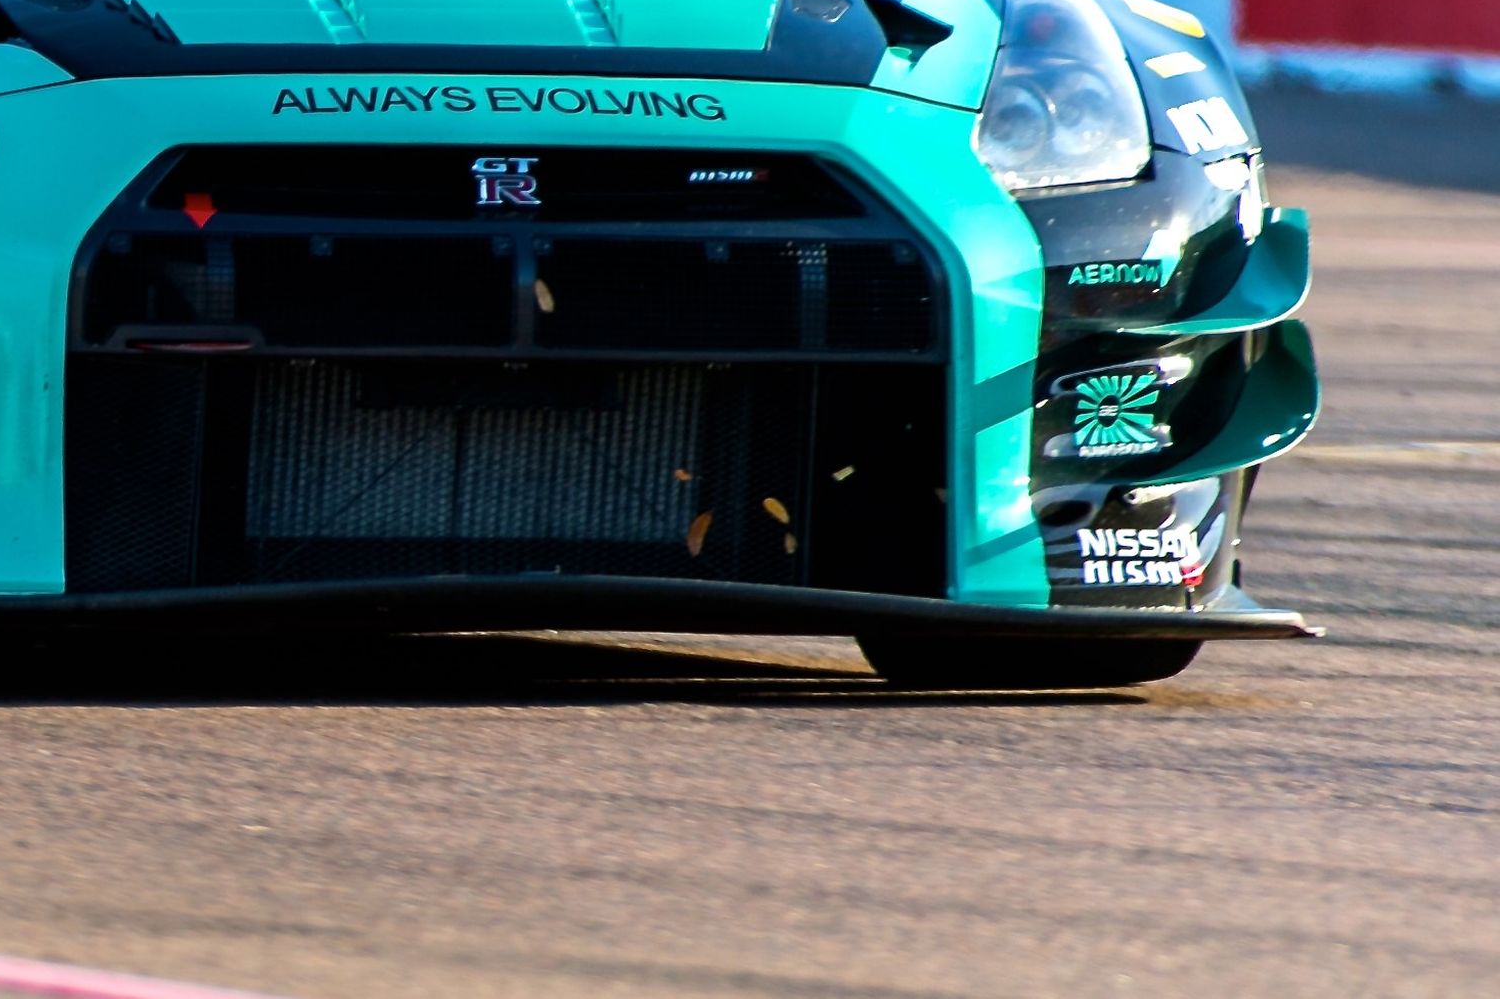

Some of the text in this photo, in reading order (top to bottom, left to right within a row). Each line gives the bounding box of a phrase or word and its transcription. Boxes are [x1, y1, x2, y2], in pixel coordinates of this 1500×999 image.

[271, 86, 727, 121] ALWAYS EVOLVING
[1077, 528, 1199, 558] NISSAN
